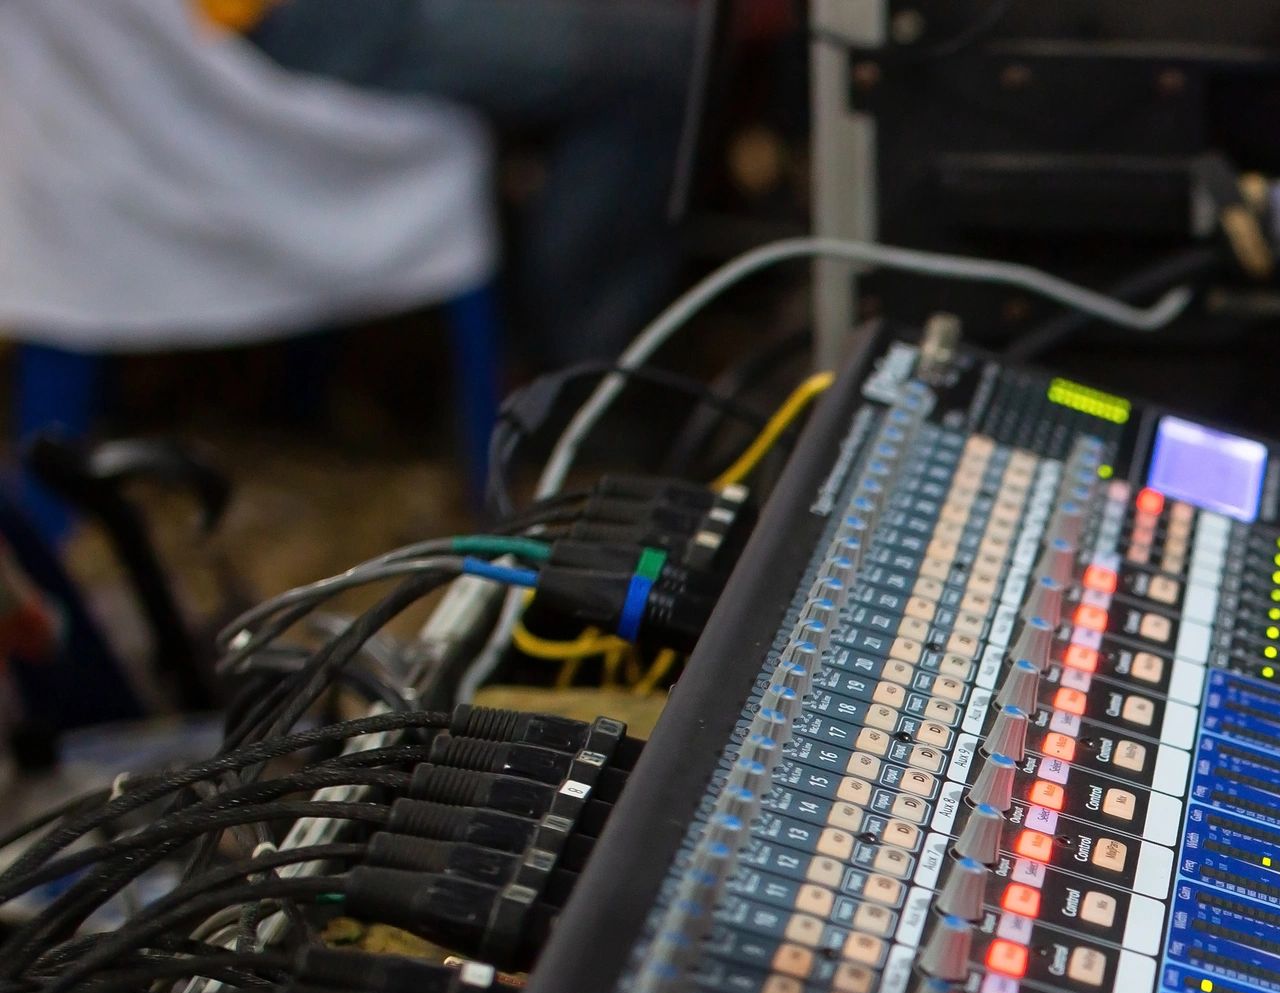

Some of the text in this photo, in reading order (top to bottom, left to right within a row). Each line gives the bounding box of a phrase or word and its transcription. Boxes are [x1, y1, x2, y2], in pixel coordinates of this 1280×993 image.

[847, 679, 866, 692] 19
[838, 702, 857, 715] 18
[829, 725, 848, 739] 17
[819, 750, 839, 763] 16
[1096, 737, 1113, 762] Control
[954, 755, 968, 768] Aux
[808, 775, 829, 788] 15
[884, 769, 899, 785] Input
[875, 793, 890, 810] Input
[1086, 785, 1103, 811] Control
[799, 801, 820, 814] 14
[939, 804, 954, 818] Aux
[1010, 806, 1024, 824] Output
[1190, 809, 1203, 822] Gain
[788, 827, 809, 841] 13
[1187, 832, 1200, 849] Width
[1074, 835, 1092, 863] Control
[925, 856, 938, 872] Aux
[1182, 859, 1198, 873] Freq
[1178, 886, 1192, 900] Gain
[1062, 888, 1080, 918] Control
